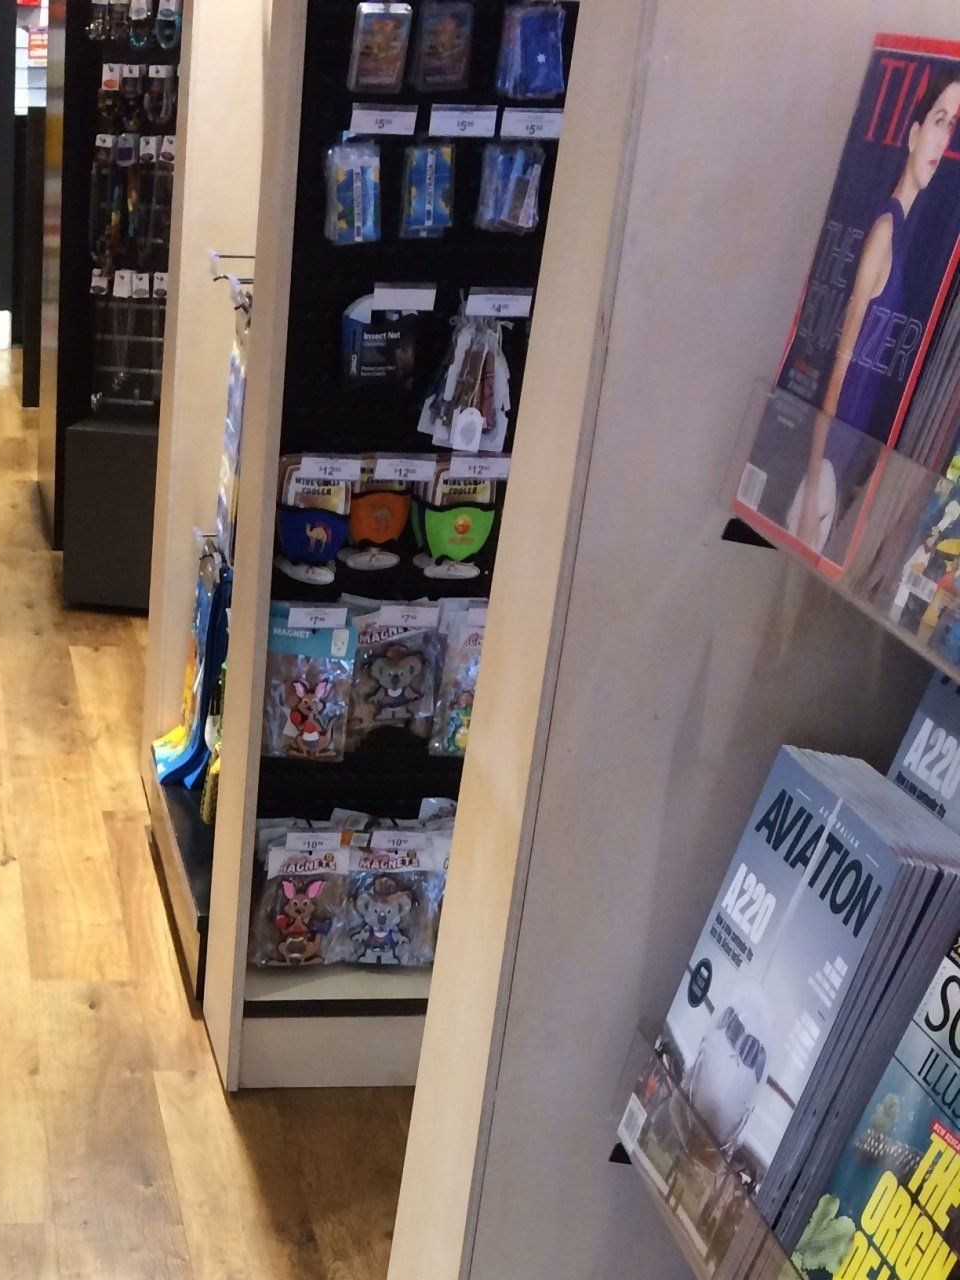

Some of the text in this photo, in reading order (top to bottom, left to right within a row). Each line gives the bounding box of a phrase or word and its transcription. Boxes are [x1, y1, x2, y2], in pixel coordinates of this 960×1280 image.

[273, 626, 311, 639] MAGNET
[358, 857, 421, 870] MAGNETS
[754, 788, 883, 939] AVIATION
[721, 862, 777, 945] A220
